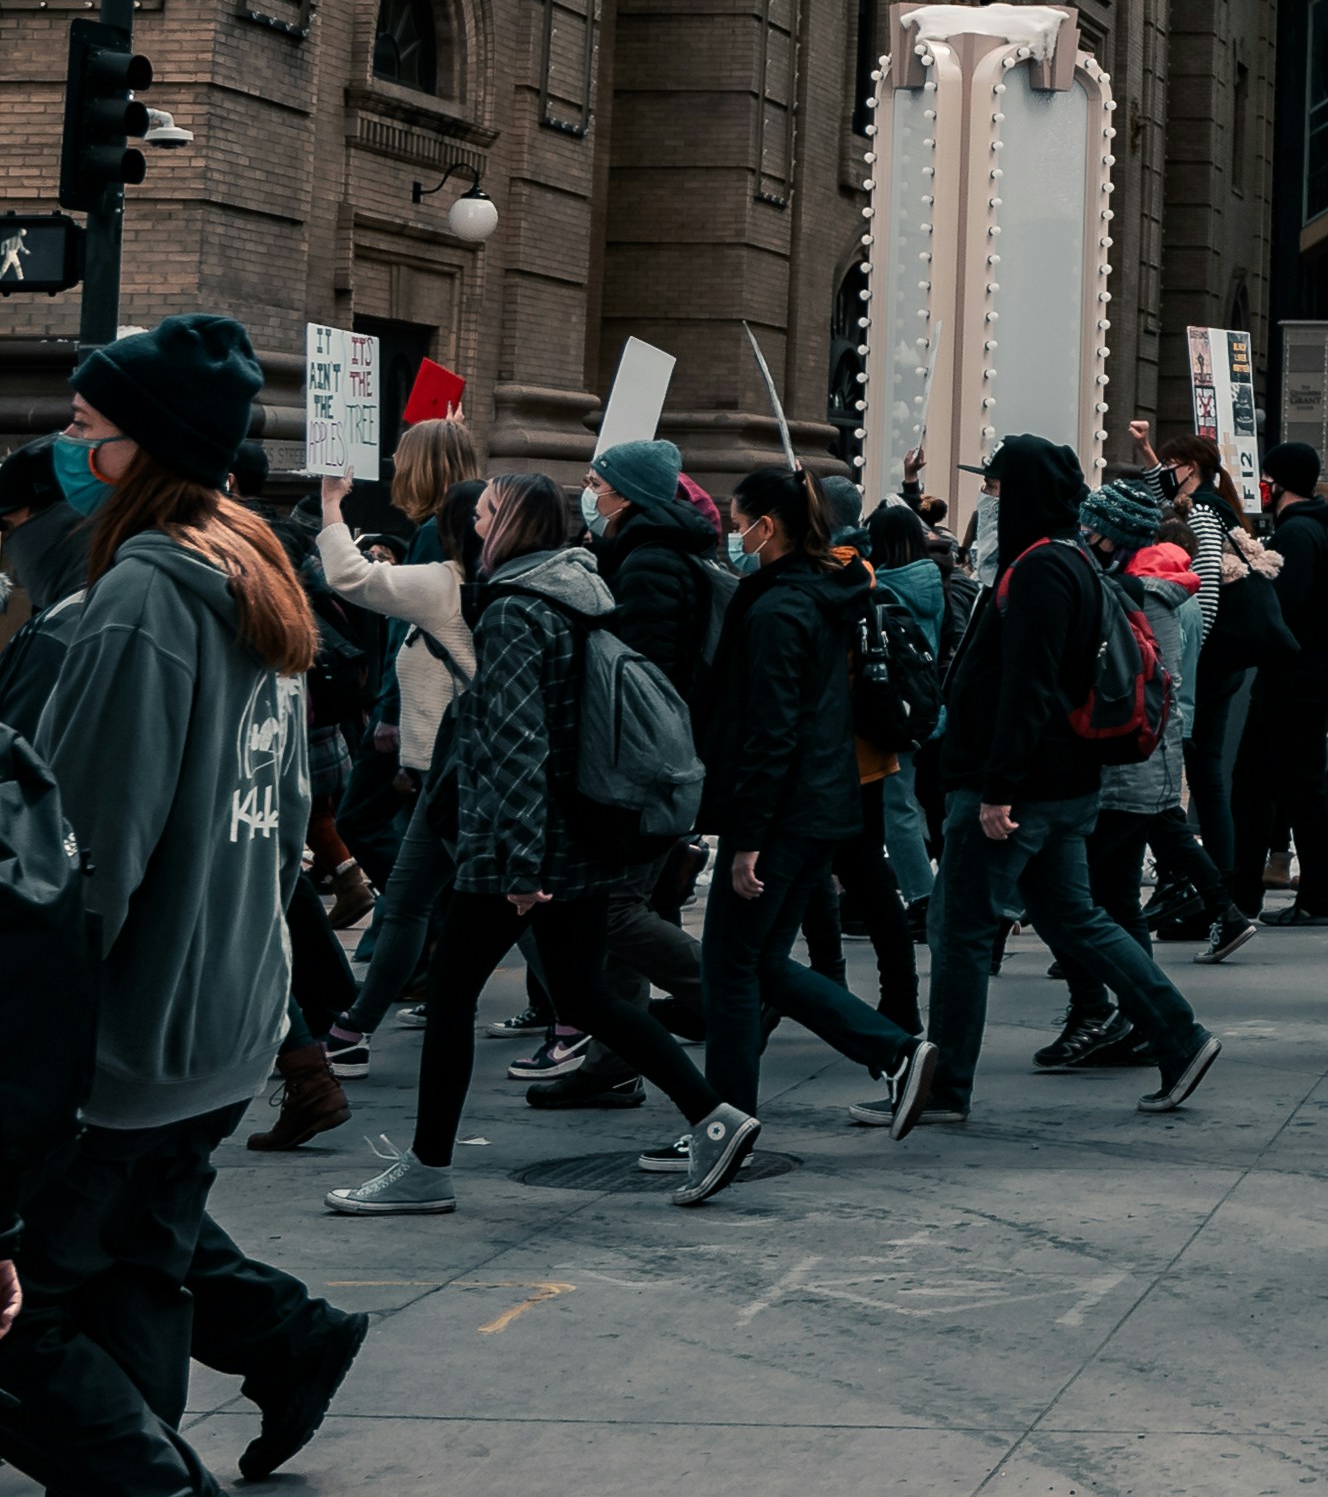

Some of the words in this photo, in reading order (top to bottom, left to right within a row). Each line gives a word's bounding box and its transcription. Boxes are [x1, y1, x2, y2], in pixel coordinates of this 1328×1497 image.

[316, 328, 332, 355] IT
[351, 336, 374, 367] ITS
[309, 361, 341, 393] AIN'T
[349, 371, 373, 398] THE
[313, 394, 334, 420] THE
[346, 404, 378, 446] TREE
[308, 421, 346, 467] APPLES
